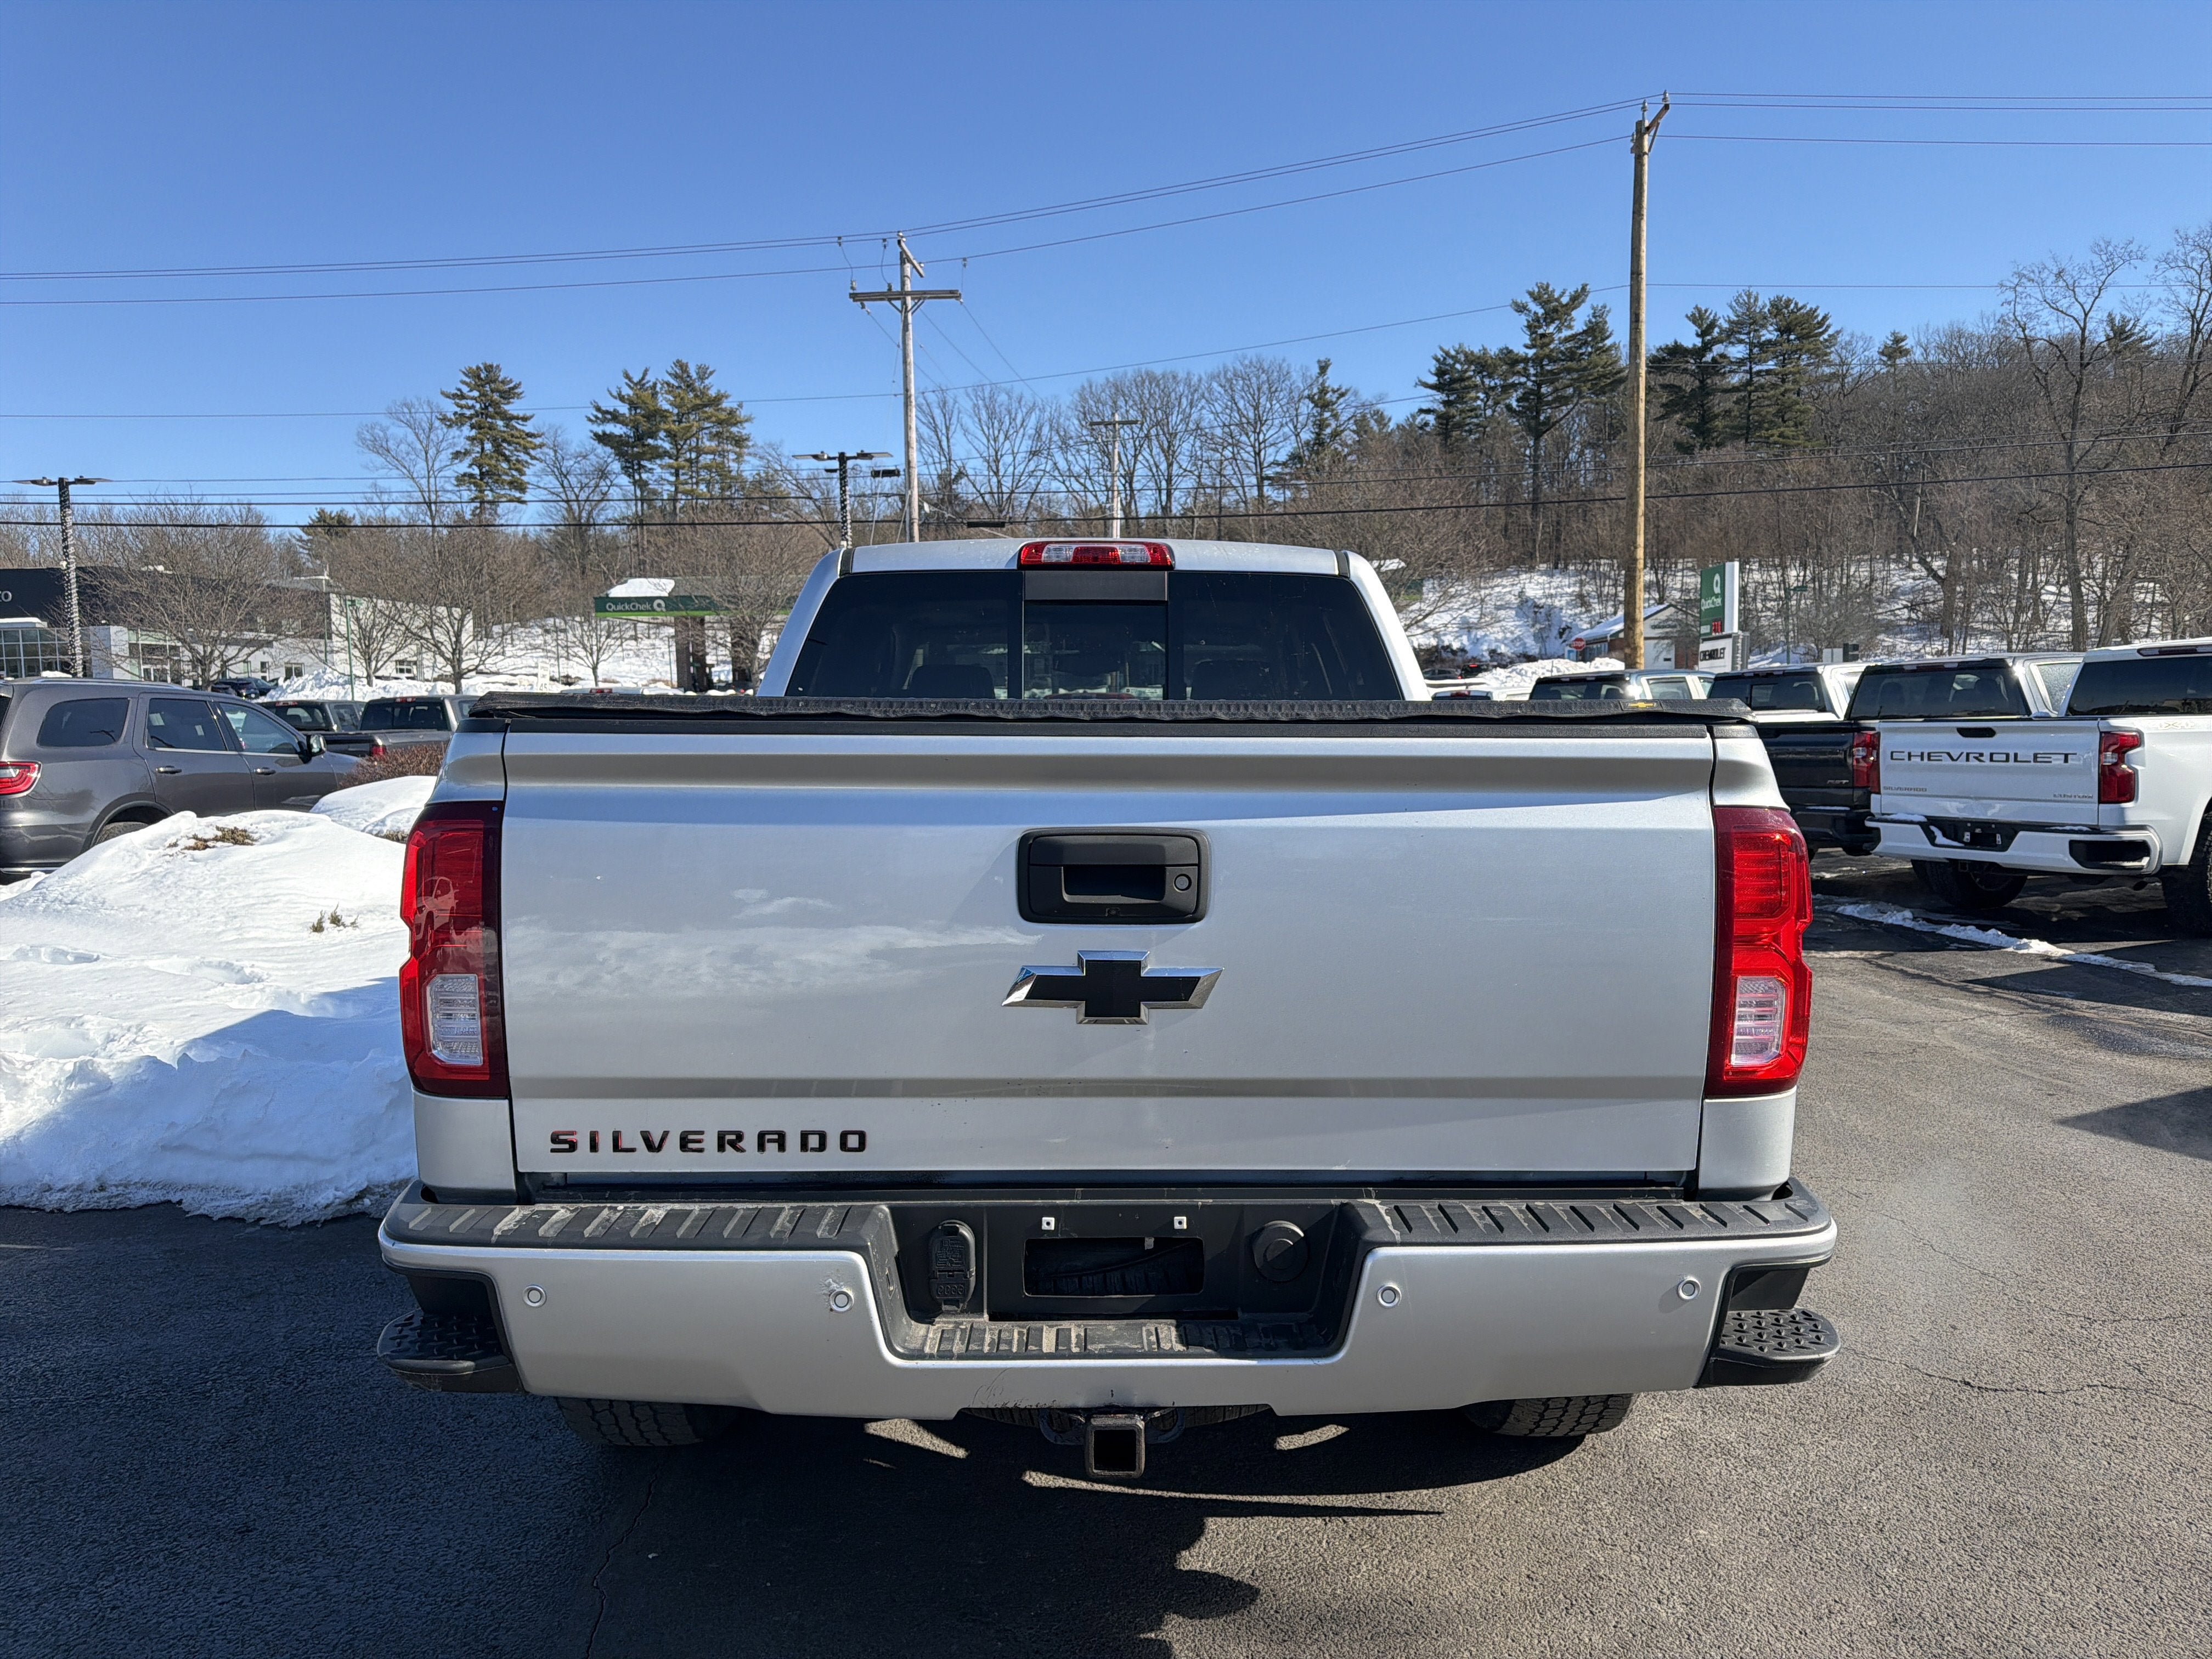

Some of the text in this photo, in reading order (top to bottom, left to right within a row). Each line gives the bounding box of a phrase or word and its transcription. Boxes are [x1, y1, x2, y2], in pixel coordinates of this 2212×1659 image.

[606, 602, 652, 612] QuickChek
[1890, 751, 2078, 764] CHEVROLET
[550, 1130, 867, 1153] SILVERADO
